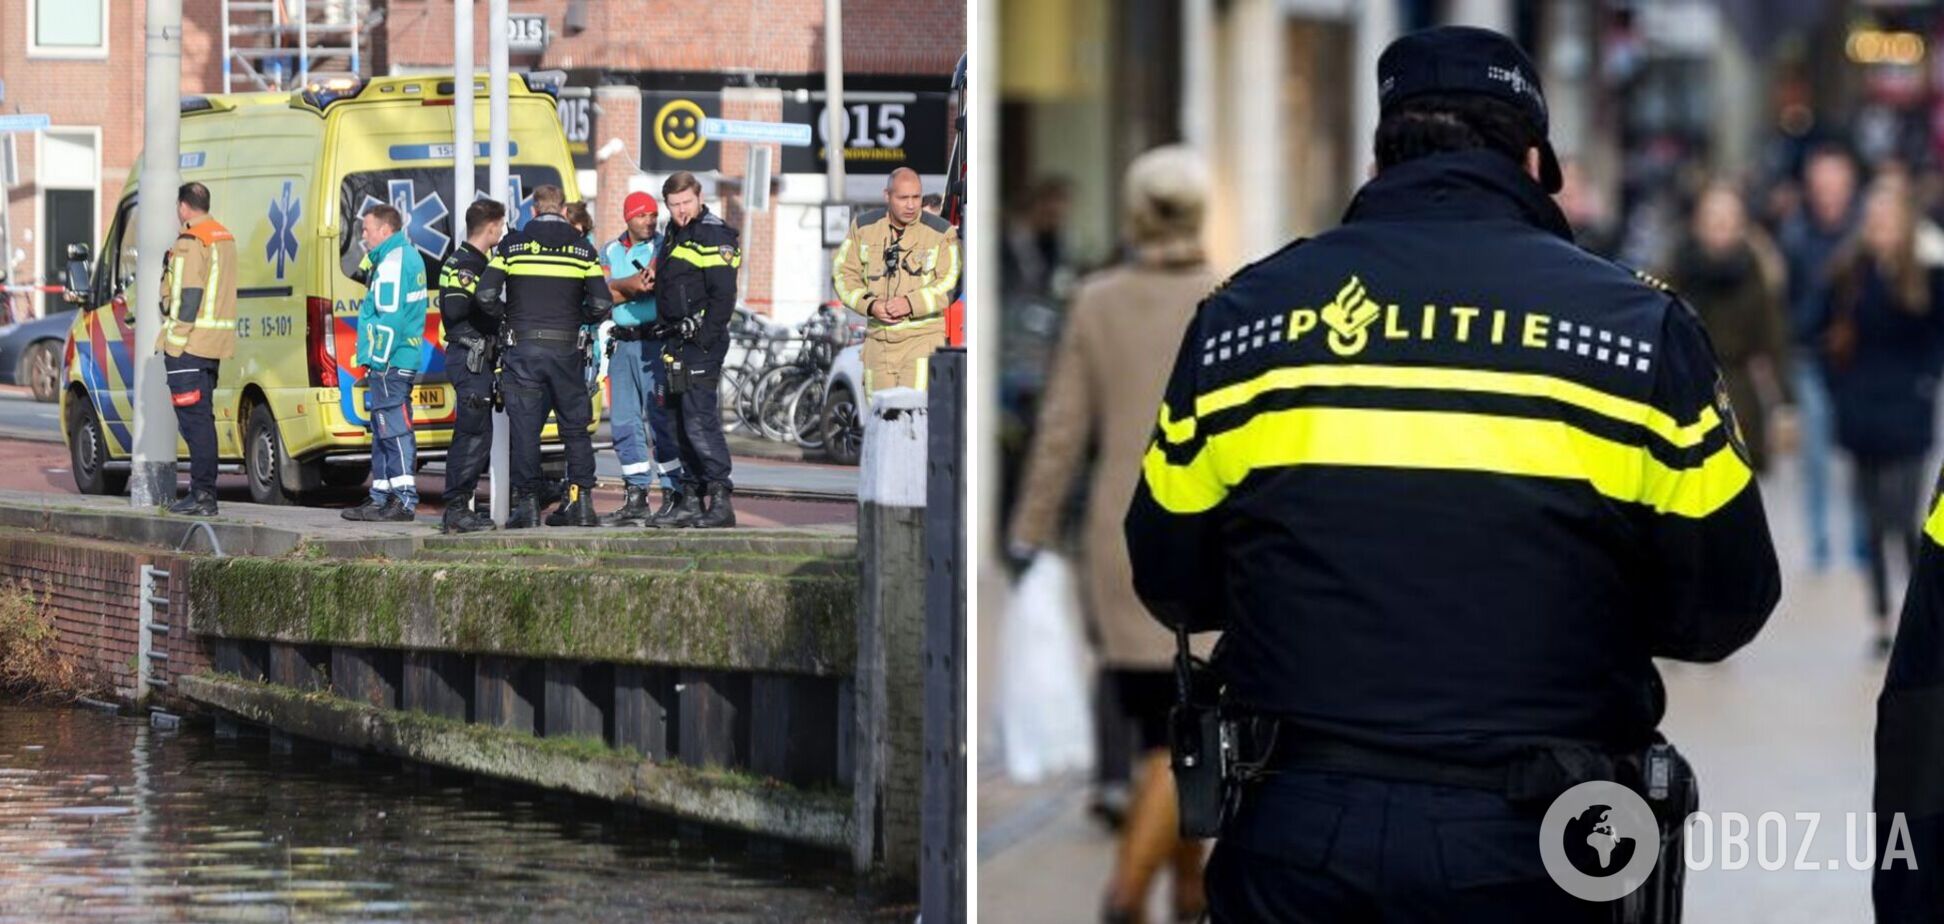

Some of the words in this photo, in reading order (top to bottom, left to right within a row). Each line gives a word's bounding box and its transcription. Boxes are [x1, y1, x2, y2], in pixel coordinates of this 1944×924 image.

[558, 98, 590, 141] 015
[818, 103, 906, 149] 015
[261, 315, 292, 337] 15-101
[1286, 278, 1550, 356] POLITIE
